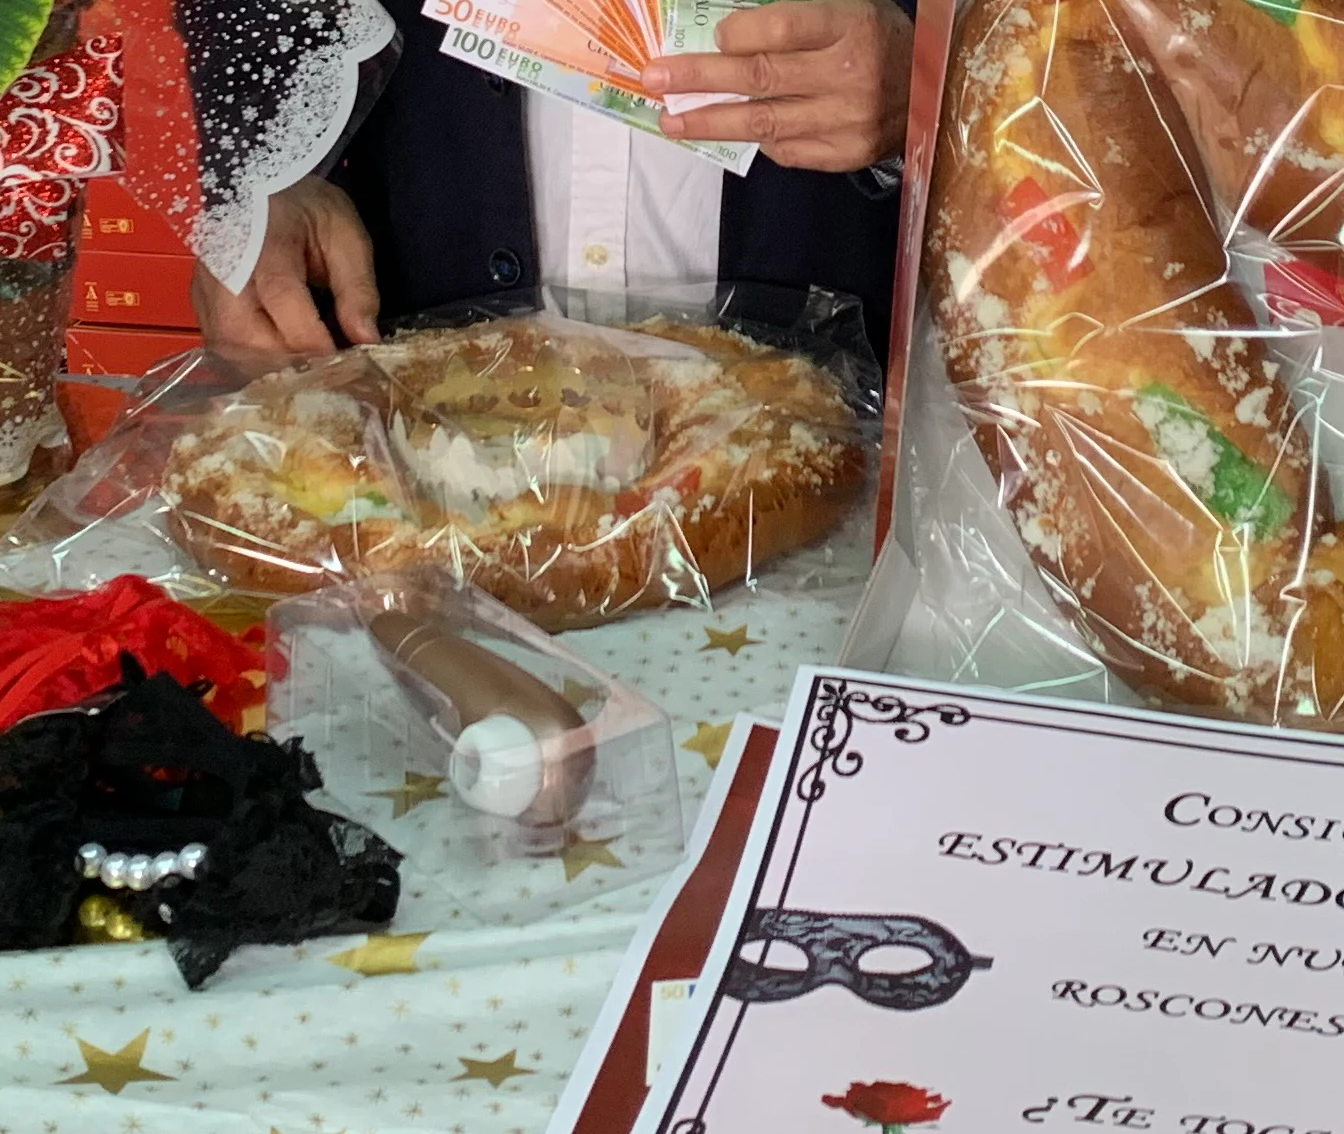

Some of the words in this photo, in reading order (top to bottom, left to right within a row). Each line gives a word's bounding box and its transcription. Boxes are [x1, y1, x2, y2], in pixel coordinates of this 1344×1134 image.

[475, 8, 521, 33] EURO
[452, 27, 496, 60] 100
[498, 47, 543, 73] EURO
[717, 145, 738, 161] 100
[1142, 927, 1237, 958] EN
